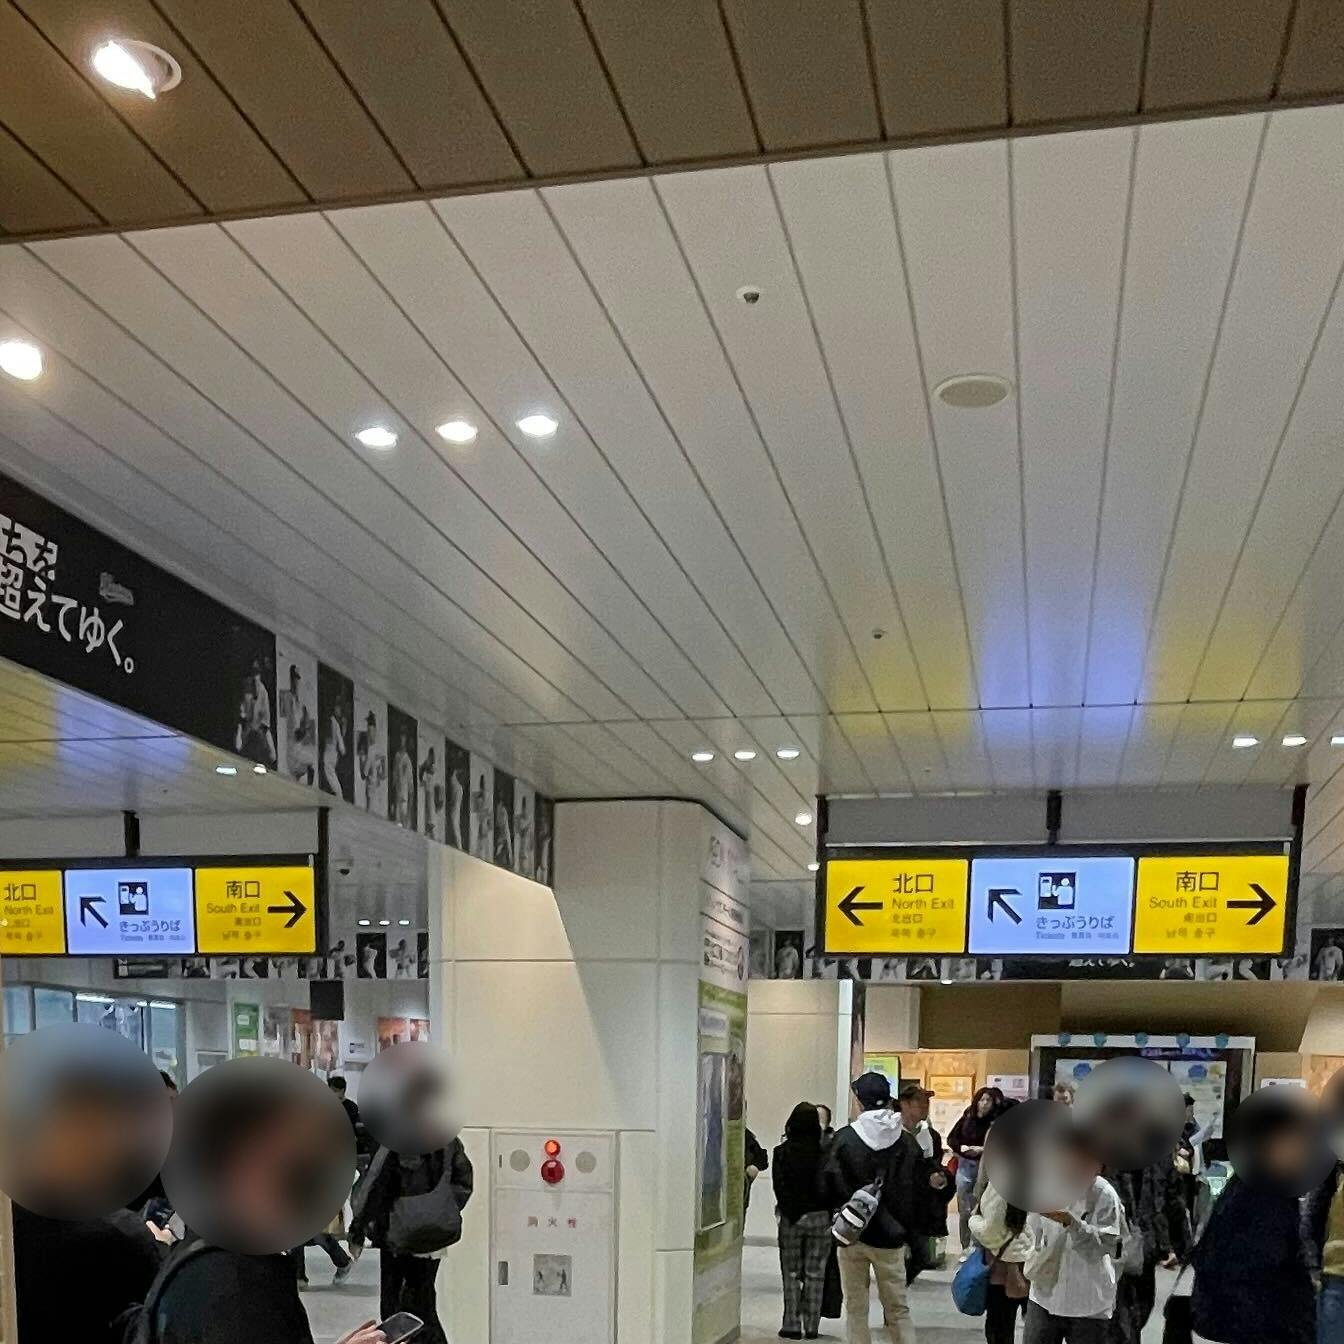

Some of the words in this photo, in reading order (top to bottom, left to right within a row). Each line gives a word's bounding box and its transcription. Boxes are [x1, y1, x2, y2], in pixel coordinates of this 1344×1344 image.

[892, 873, 934, 893] 北口
[1176, 871, 1219, 892] 南口
[3, 883, 36, 901] 北口
[226, 881, 260, 898] 南口
[207, 903, 236, 913] South
[240, 903, 260, 913] Exit
[892, 898, 927, 909] North
[931, 898, 954, 909] Exit
[1150, 896, 1187, 909] South
[1192, 896, 1217, 909] Exit
[120, 920, 181, 932] きっぷうりば
[1037, 915, 1115, 930] きっぷうりば
